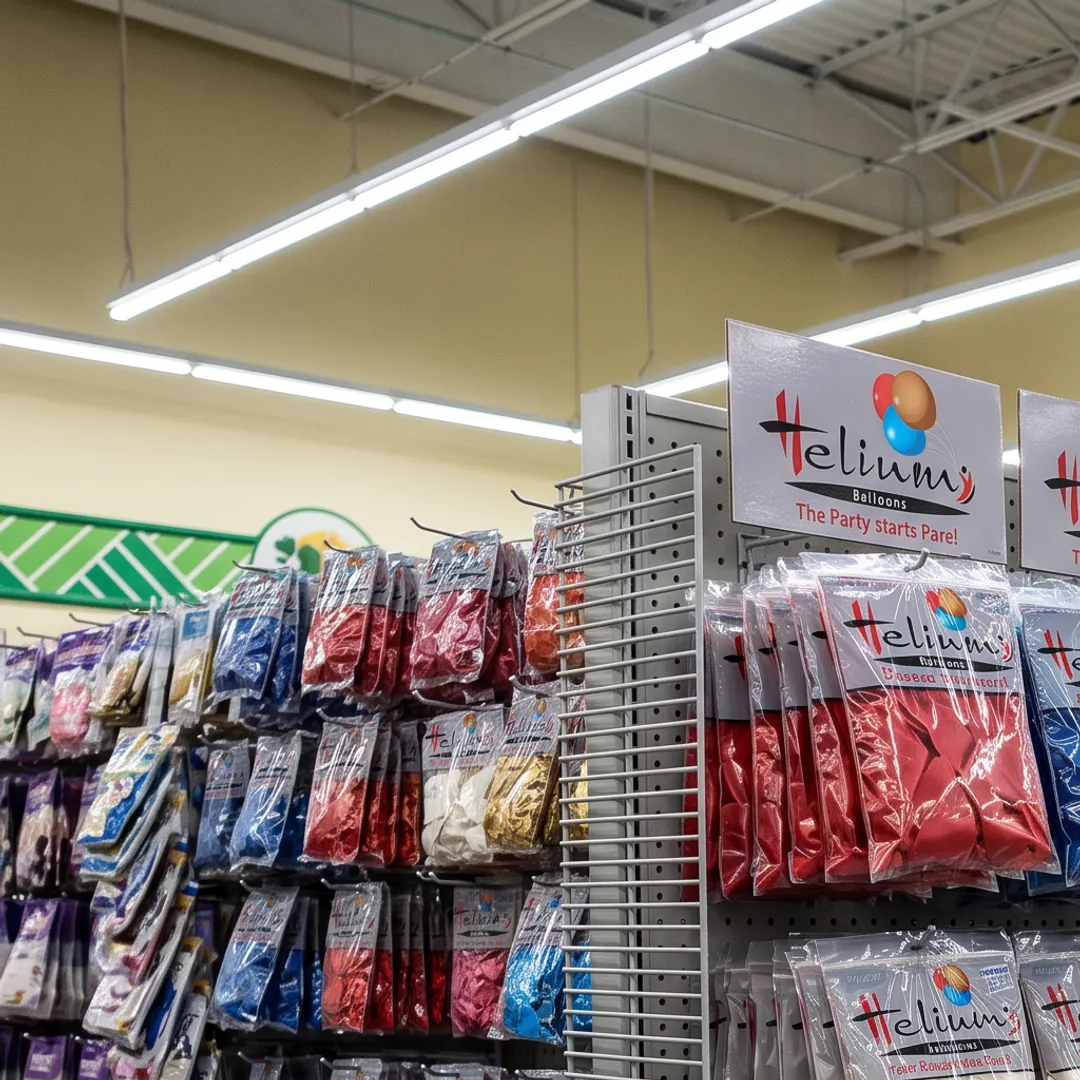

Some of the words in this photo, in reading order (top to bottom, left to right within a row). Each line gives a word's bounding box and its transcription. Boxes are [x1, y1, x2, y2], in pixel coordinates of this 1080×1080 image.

[853, 489, 907, 510] Balloons
[796, 503, 825, 524] The
[831, 508, 870, 535] Party
[875, 519, 917, 539] starts
[922, 524, 958, 545] Pare!
